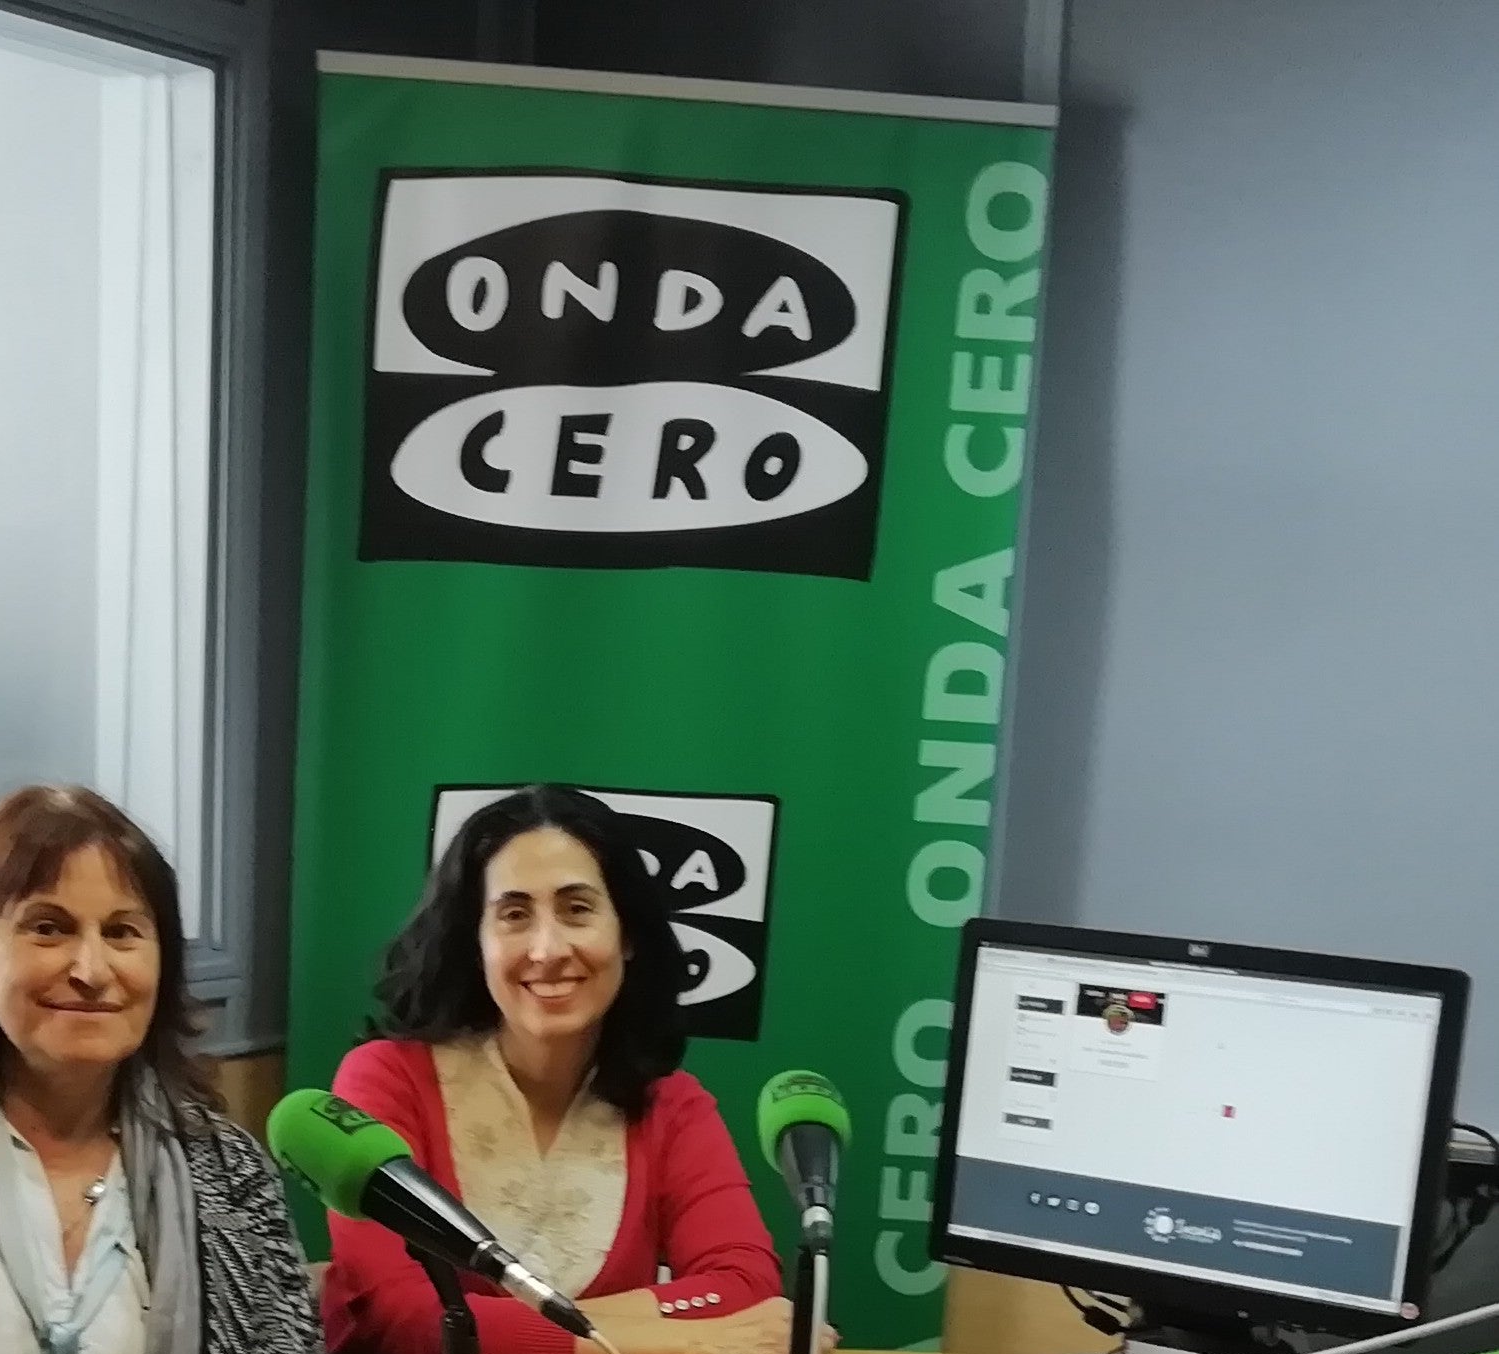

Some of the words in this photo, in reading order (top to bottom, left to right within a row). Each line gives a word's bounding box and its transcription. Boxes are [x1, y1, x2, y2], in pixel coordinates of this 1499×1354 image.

[446, 255, 813, 342] ONDA
[943, 161, 1049, 497] CERO
[459, 408, 803, 503] CERO
[906, 546, 1015, 928] ONDA
[872, 998, 955, 1296] CERO
